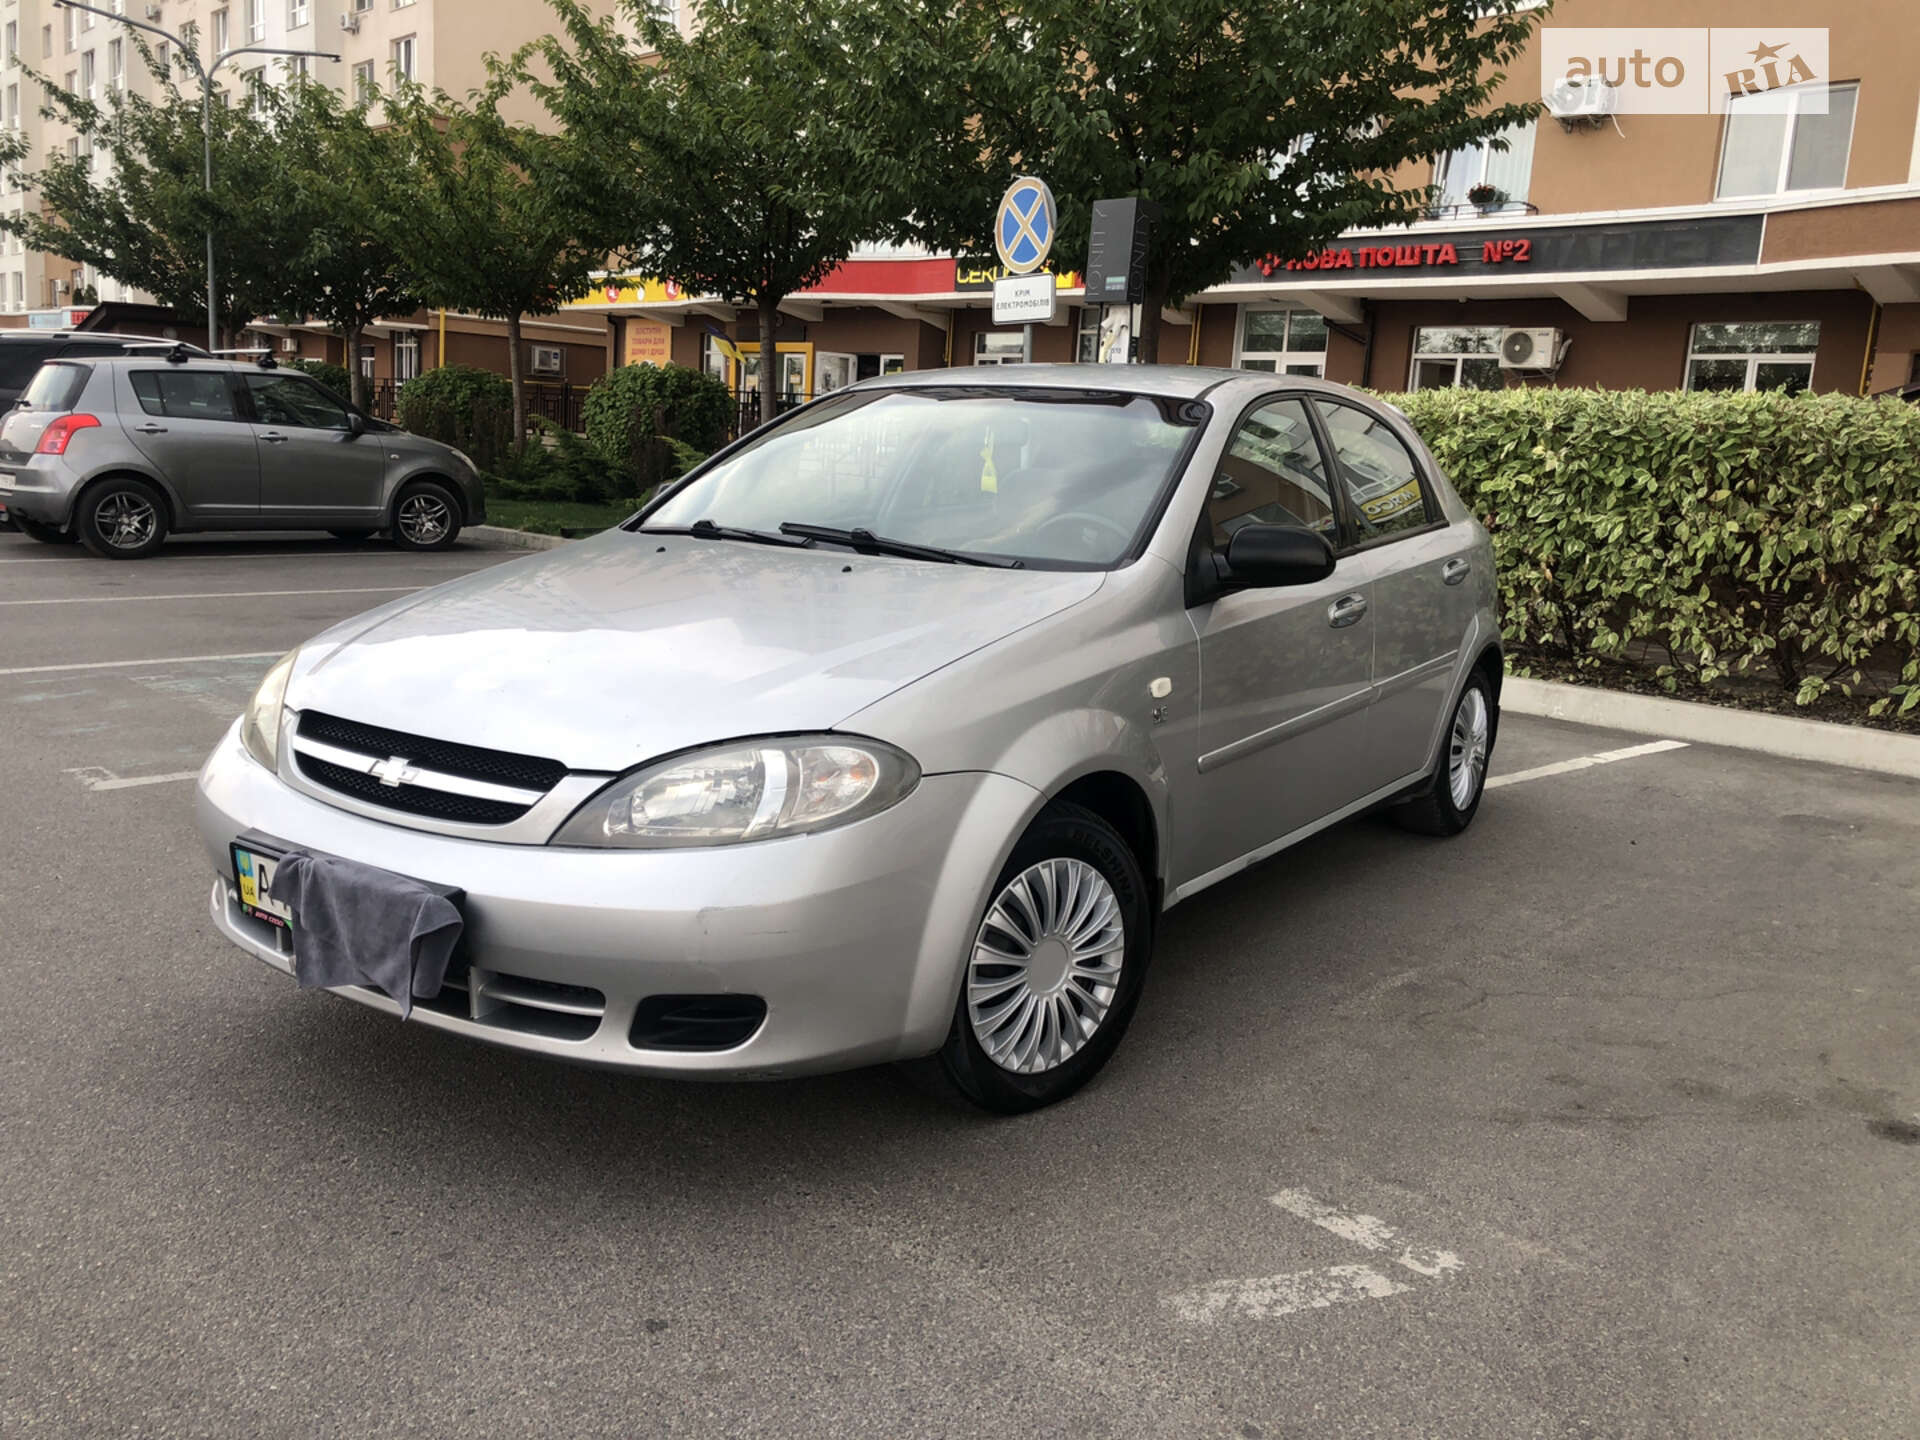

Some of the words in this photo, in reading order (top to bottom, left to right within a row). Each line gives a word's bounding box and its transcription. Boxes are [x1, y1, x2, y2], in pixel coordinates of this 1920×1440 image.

[1087, 208, 1107, 296] IONITY
[1358, 243, 1458, 267] ПОШТА
[244, 883, 255, 897] UA
